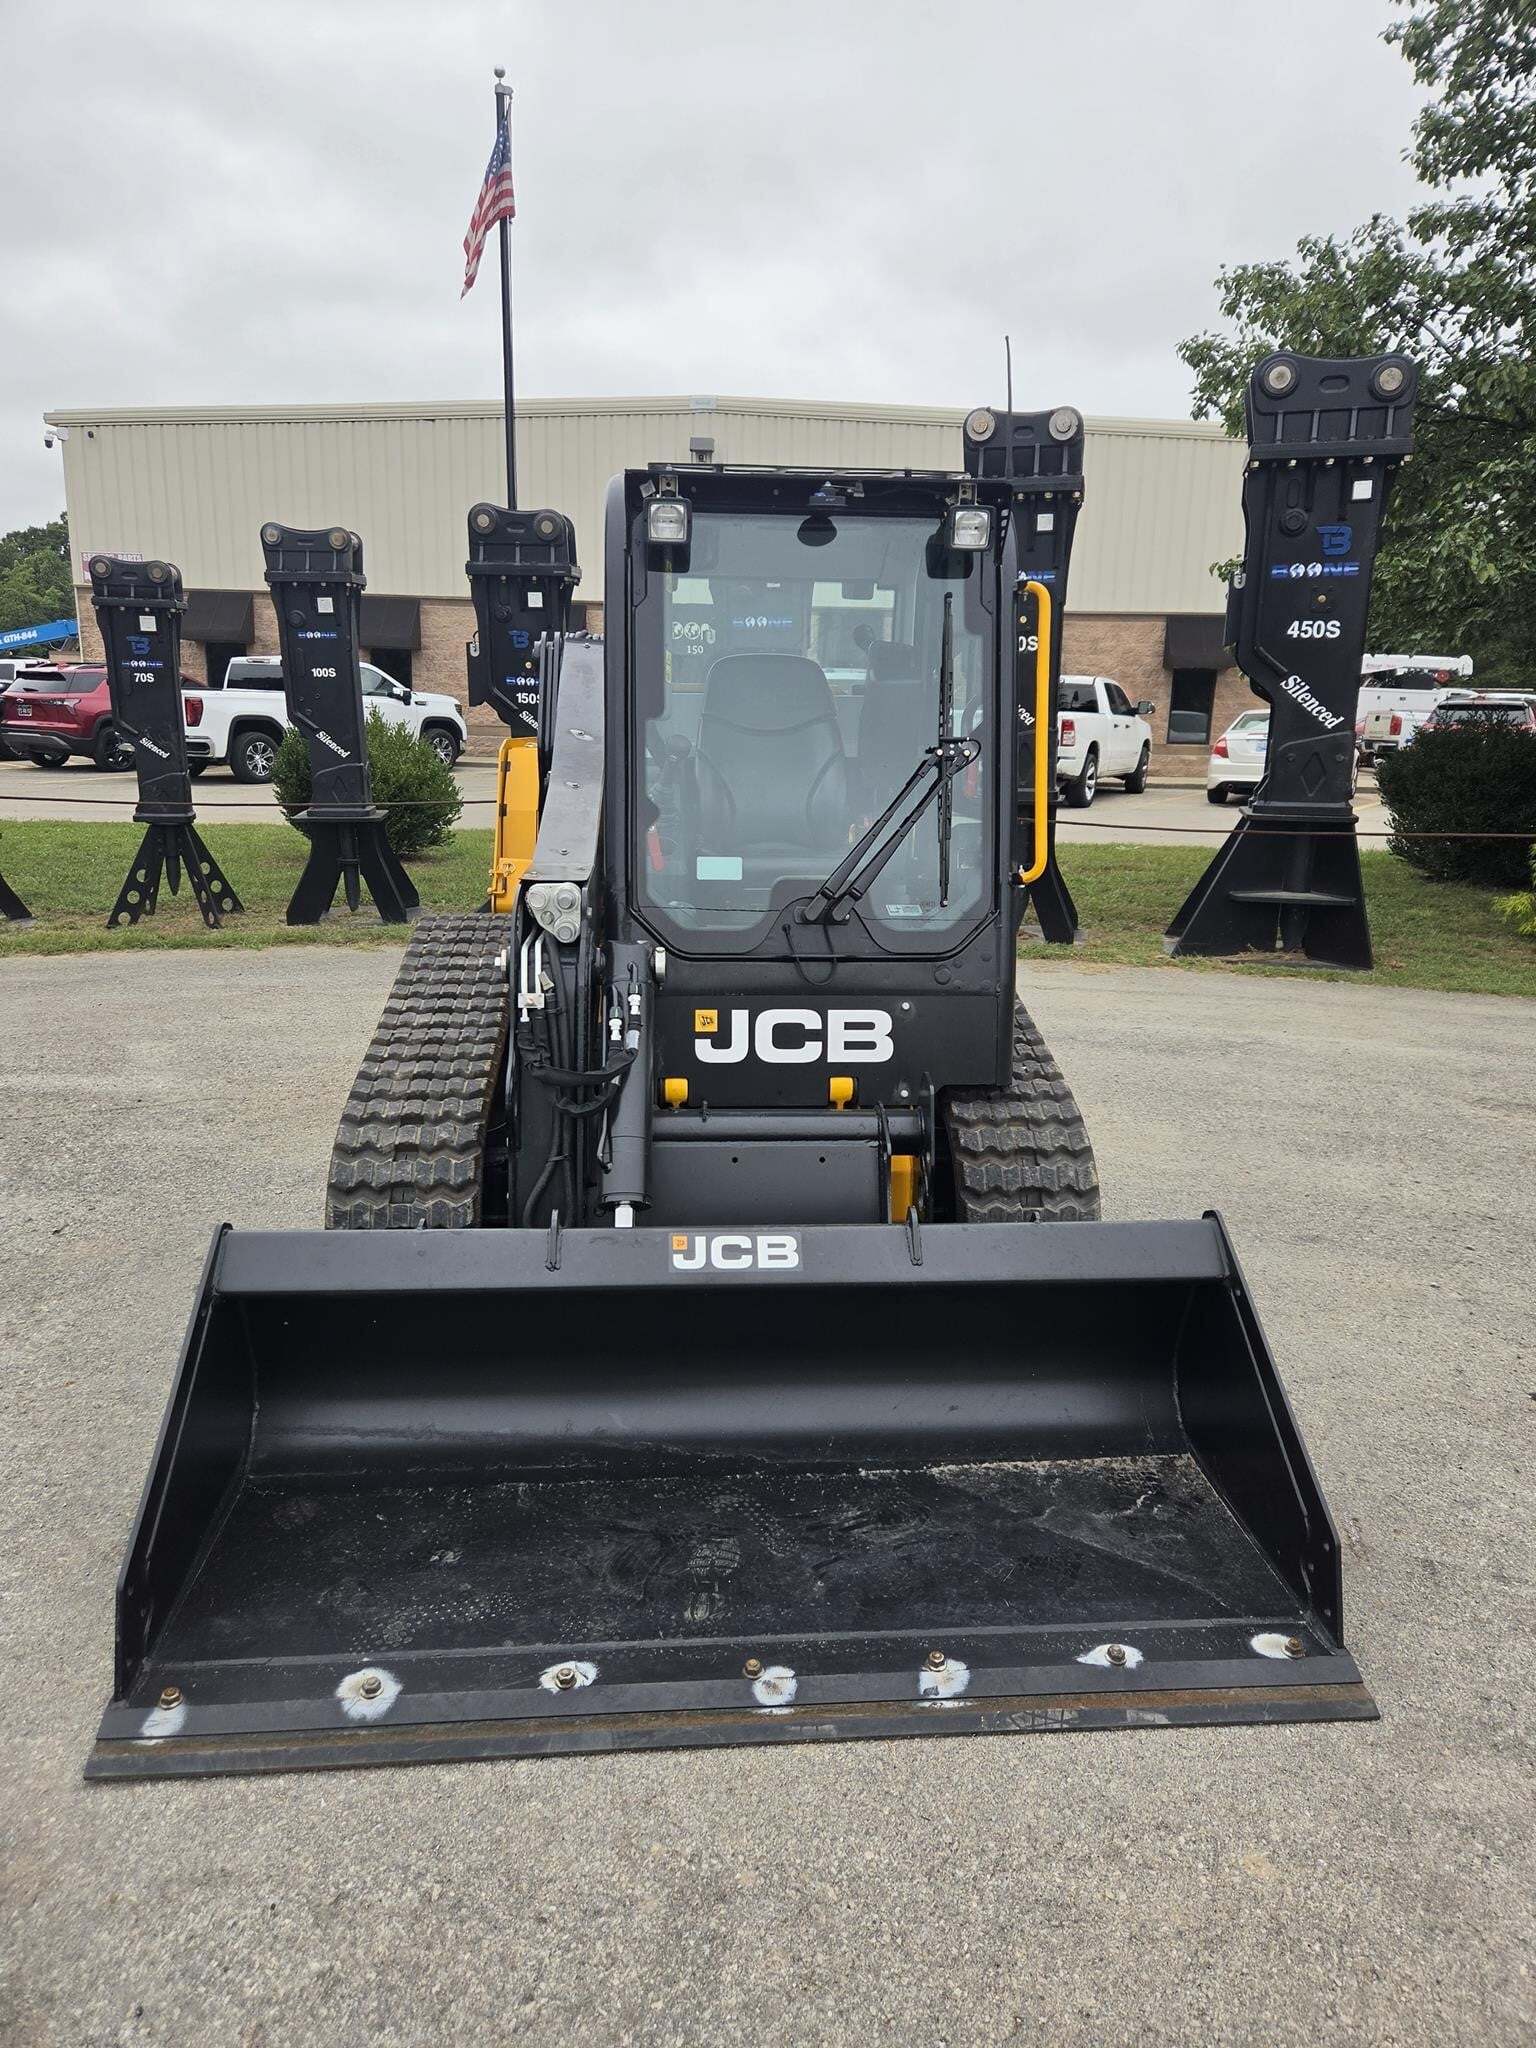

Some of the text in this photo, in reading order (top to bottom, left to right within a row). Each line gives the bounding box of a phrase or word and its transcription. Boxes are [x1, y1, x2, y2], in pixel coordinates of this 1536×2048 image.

[4, 630, 38, 643] GTH-844
[1286, 620, 1341, 638] 450S
[687, 645, 704, 655] 150
[1019, 636, 1038, 651] 0S
[133, 672, 155, 683] 70S
[311, 667, 337, 678] 100S
[1280, 675, 1345, 729] Silenced
[519, 710, 540, 731] Silen
[139, 736, 170, 759] Silenced
[315, 731, 351, 758] Silenced
[695, 1009, 894, 1063] JCB
[673, 1235, 799, 1269] JCB
